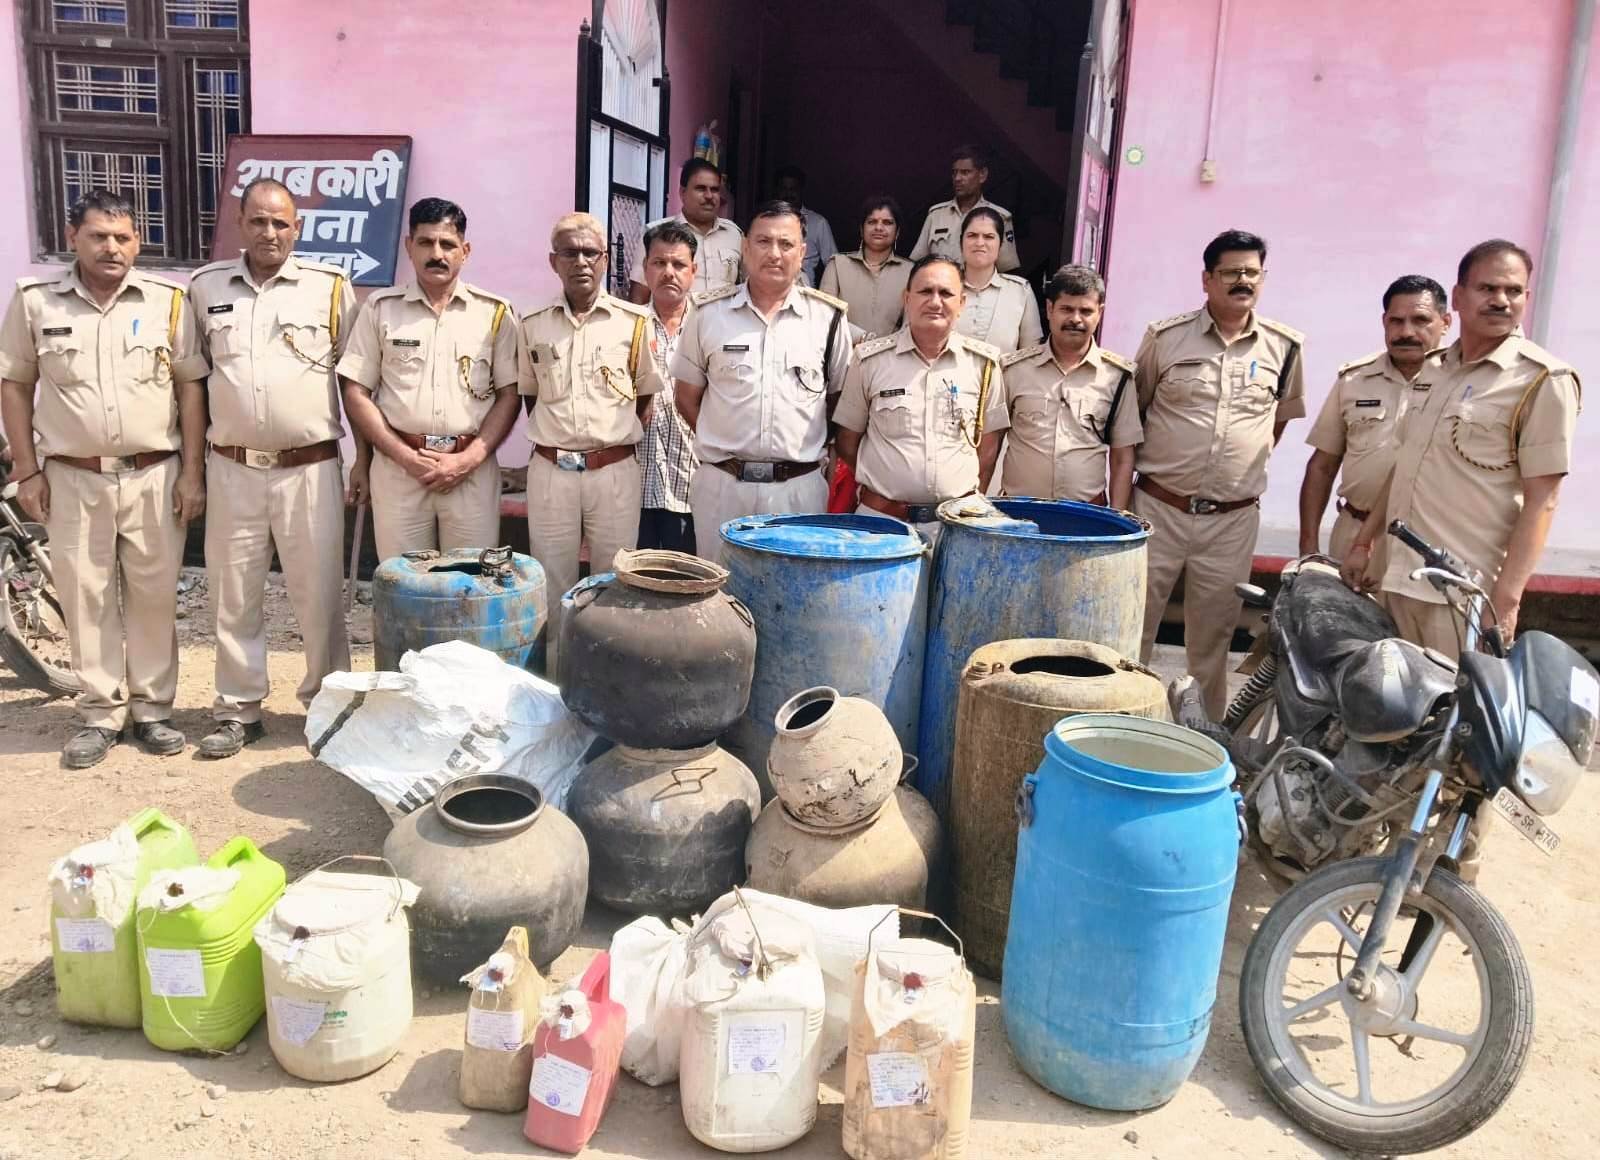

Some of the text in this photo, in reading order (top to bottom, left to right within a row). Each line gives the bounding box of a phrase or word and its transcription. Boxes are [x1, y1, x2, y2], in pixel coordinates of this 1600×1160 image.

[230, 149, 403, 207] आबकारी
[296, 209, 368, 243] ाना
[1520, 814, 1535, 831] SR
